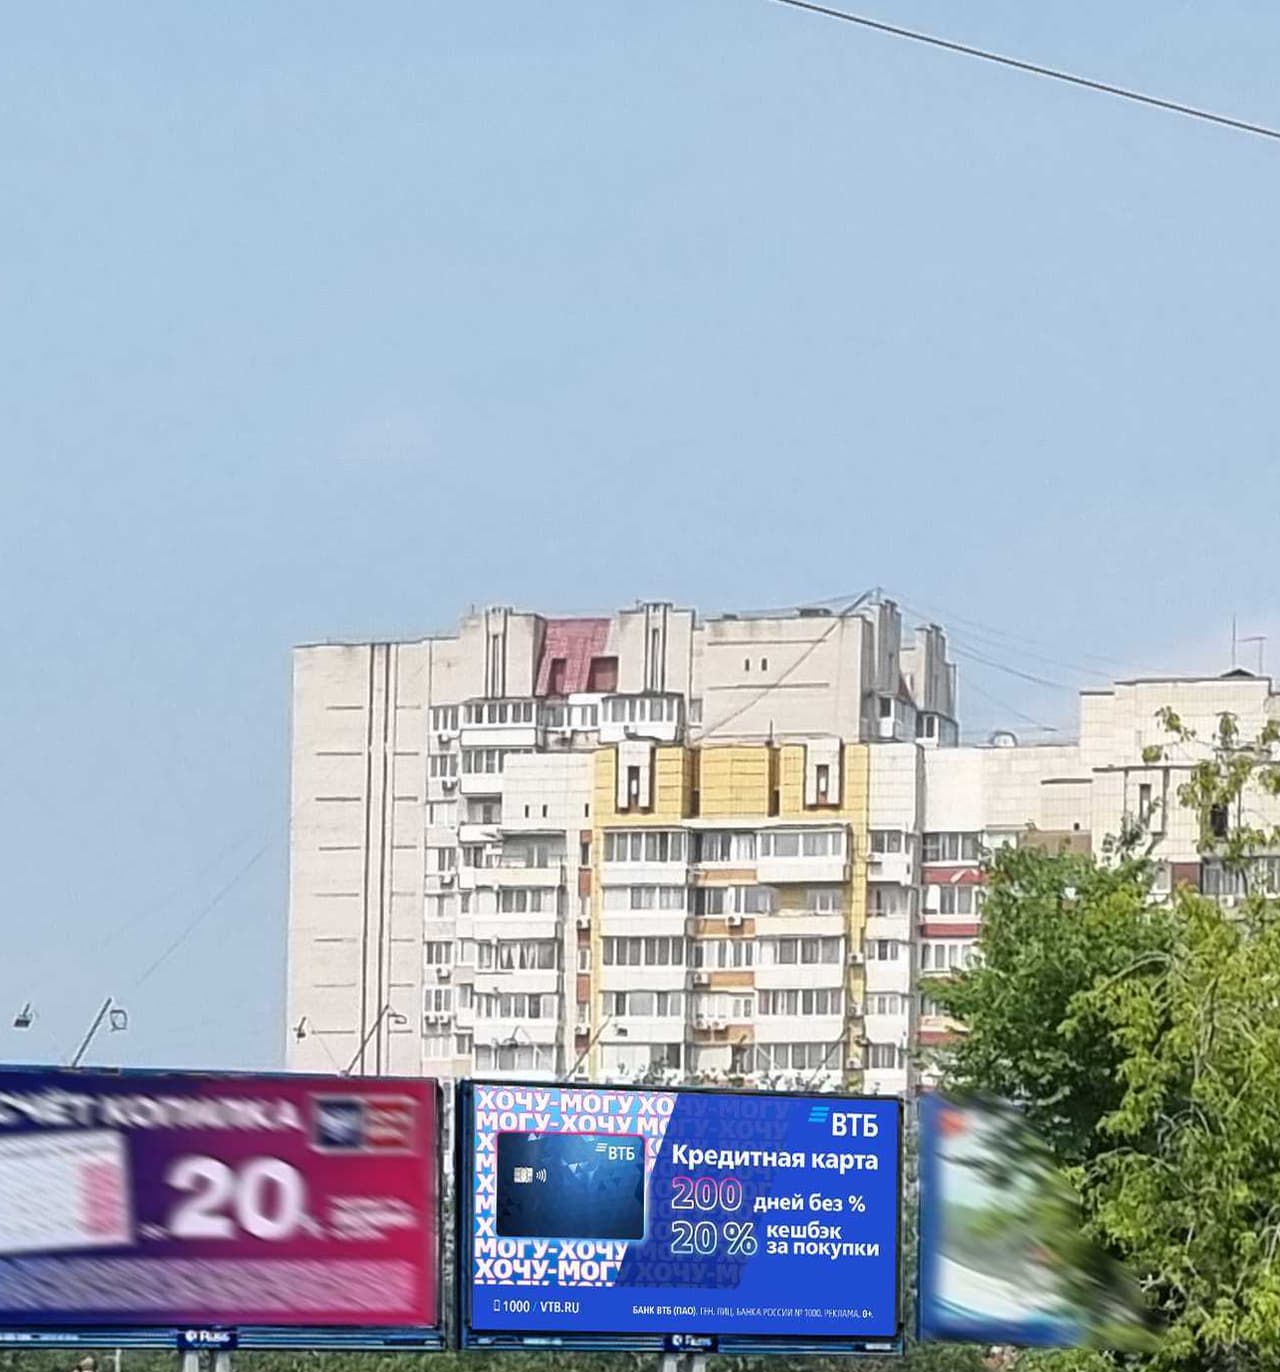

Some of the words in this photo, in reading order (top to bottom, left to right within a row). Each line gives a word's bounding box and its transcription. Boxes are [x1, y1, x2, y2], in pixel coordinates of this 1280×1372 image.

[477, 1091, 634, 1113] ХОЧУ-МОГУ
[476, 1112, 632, 1134] МОГУ-ХОЧУ
[832, 1112, 879, 1137] ВТБ
[608, 1146, 636, 1160] ВТБ
[672, 1144, 805, 1170] Кредитная
[812, 1152, 879, 1175] карта
[166, 1156, 307, 1240] 20
[671, 1176, 742, 1211] 200
[753, 1193, 804, 1213] дней
[809, 1193, 843, 1211] без
[848, 1195, 866, 1212] %
[766, 1221, 842, 1239] кешбэк
[475, 1238, 628, 1260] МОГУ-ХОЧУ
[766, 1242, 792, 1254] за
[794, 1243, 880, 1260] покупки
[503, 1300, 530, 1313] 1000
[540, 1301, 580, 1314] VTB.RU
[632, 1305, 655, 1315] БАНК
[656, 1306, 672, 1315] ВТБ
